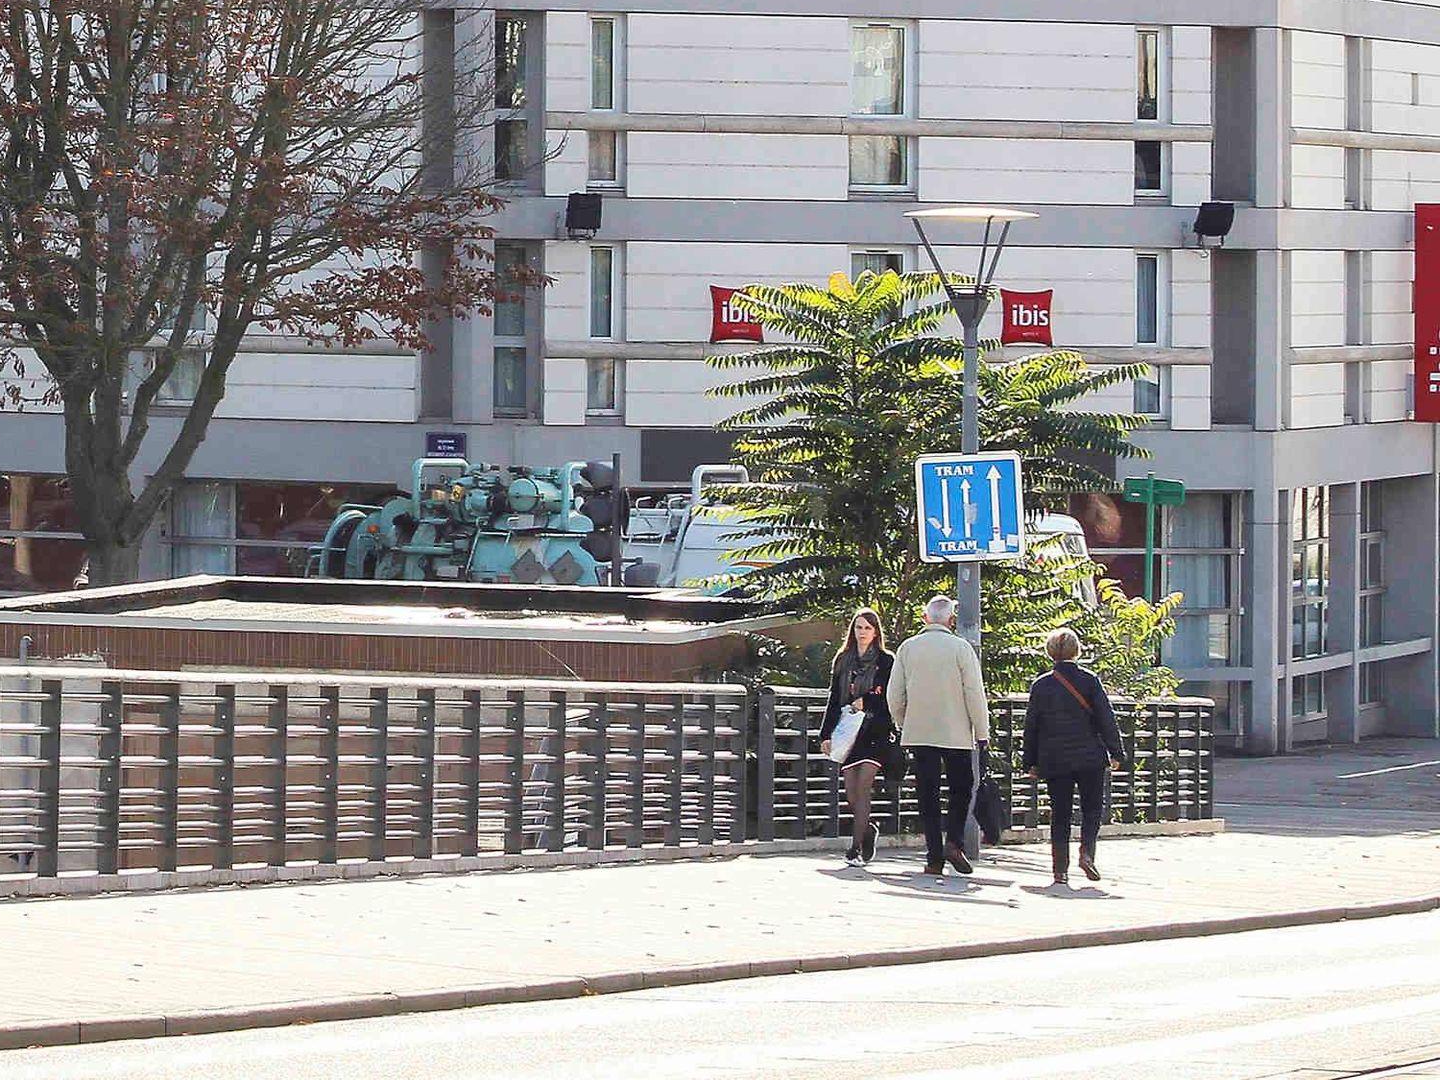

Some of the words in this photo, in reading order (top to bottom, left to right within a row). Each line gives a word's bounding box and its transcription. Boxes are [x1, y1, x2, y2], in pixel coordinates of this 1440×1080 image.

[1012, 304, 1049, 326] ibis
[934, 465, 974, 477] TRAM
[938, 539, 978, 552] TRAM
